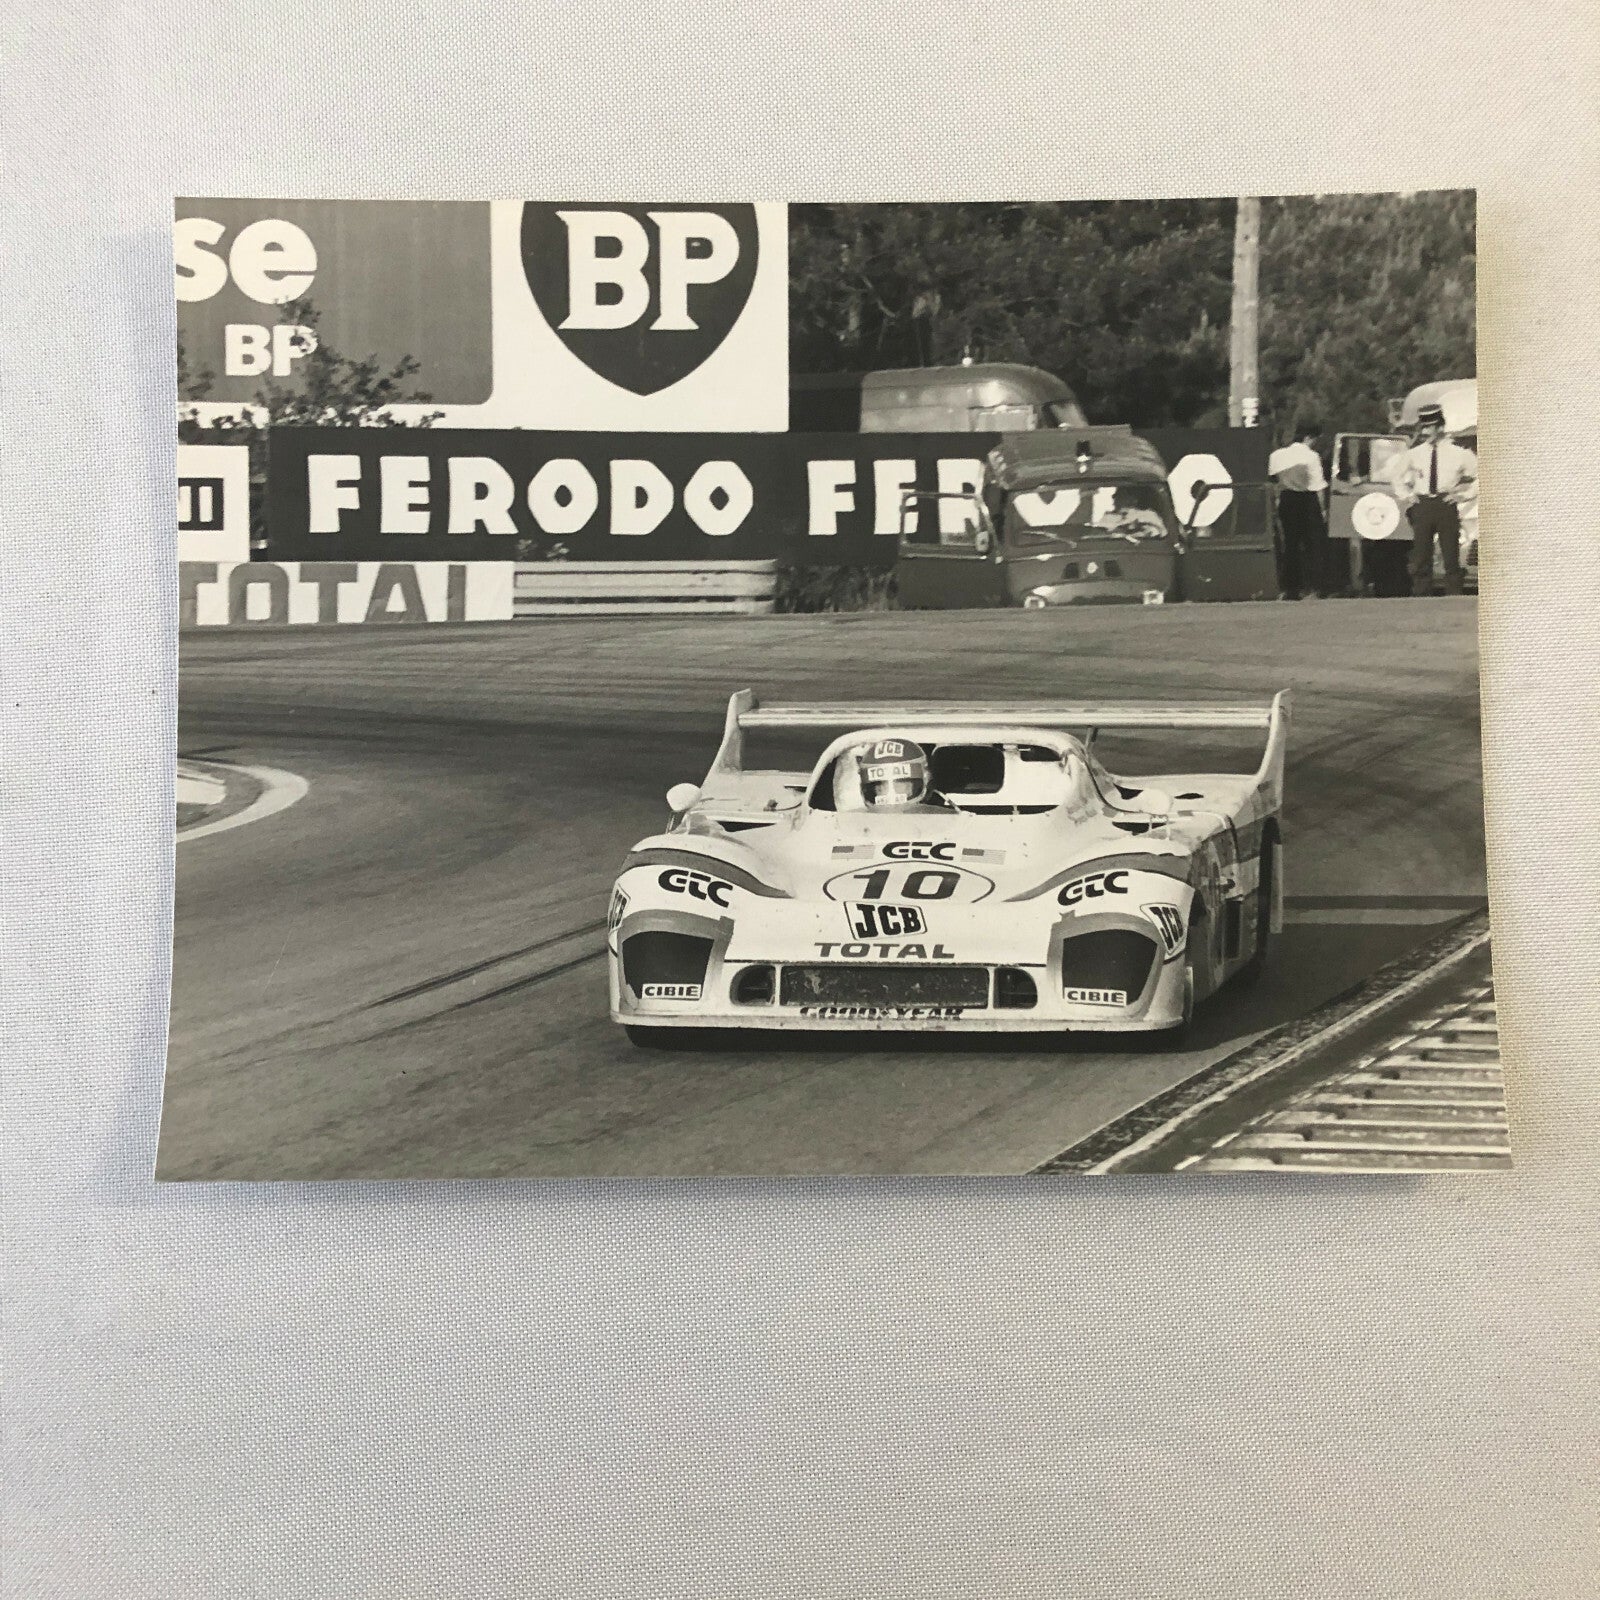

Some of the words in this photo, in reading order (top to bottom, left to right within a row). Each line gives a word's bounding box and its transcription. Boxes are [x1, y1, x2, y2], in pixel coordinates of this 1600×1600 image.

[554, 210, 741, 331] BP
[225, 324, 318, 377] BP
[307, 454, 754, 537] FERODO
[807, 453, 1234, 541] FEROO
[878, 743, 902, 754] JCB
[870, 765, 908, 778] TOAL
[882, 841, 956, 861] GTC
[658, 868, 734, 908] GTC
[853, 869, 961, 900] 10
[1057, 870, 1129, 906] GTC
[855, 903, 922, 939] JCB
[1149, 906, 1184, 950] JCB
[814, 942, 955, 959] TOTAL
